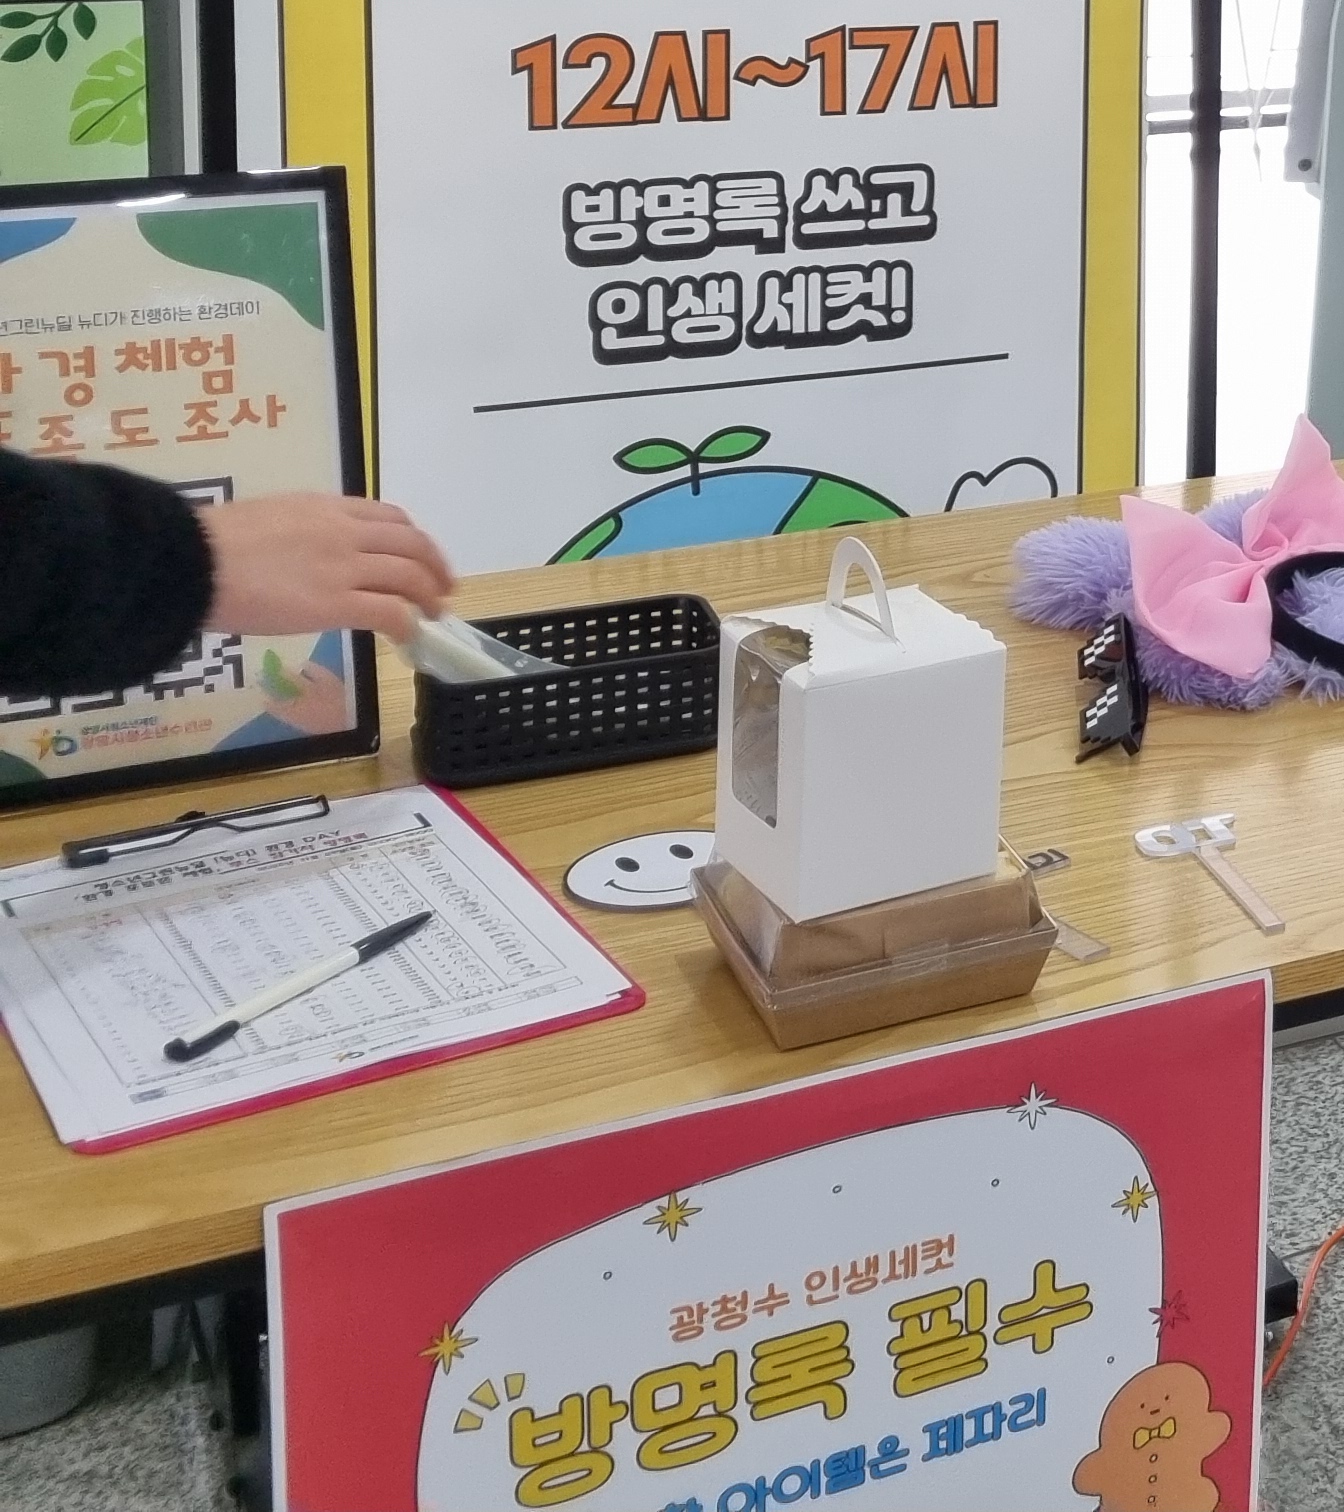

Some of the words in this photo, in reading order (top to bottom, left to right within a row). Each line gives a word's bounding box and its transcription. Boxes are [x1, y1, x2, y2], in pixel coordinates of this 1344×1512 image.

[511, 20, 999, 131] 12시~17시
[562, 170, 788, 267] 방명록
[793, 163, 937, 250] 쓰고
[77, 310, 124, 330] 뉴디가
[130, 305, 193, 326] 진행하는
[197, 300, 261, 321] 환경데이
[114, 333, 235, 395] 체험
[588, 271, 742, 365] 인생
[745, 260, 913, 349] 세컷!
[175, 394, 287, 444] 조사
[669, 1282, 791, 1343] 광청수
[803, 1233, 956, 1307] 인생세컷
[509, 1320, 855, 1507] 방명록
[886, 1259, 1094, 1399] 필수
[921, 1386, 1047, 1463] 제자리
